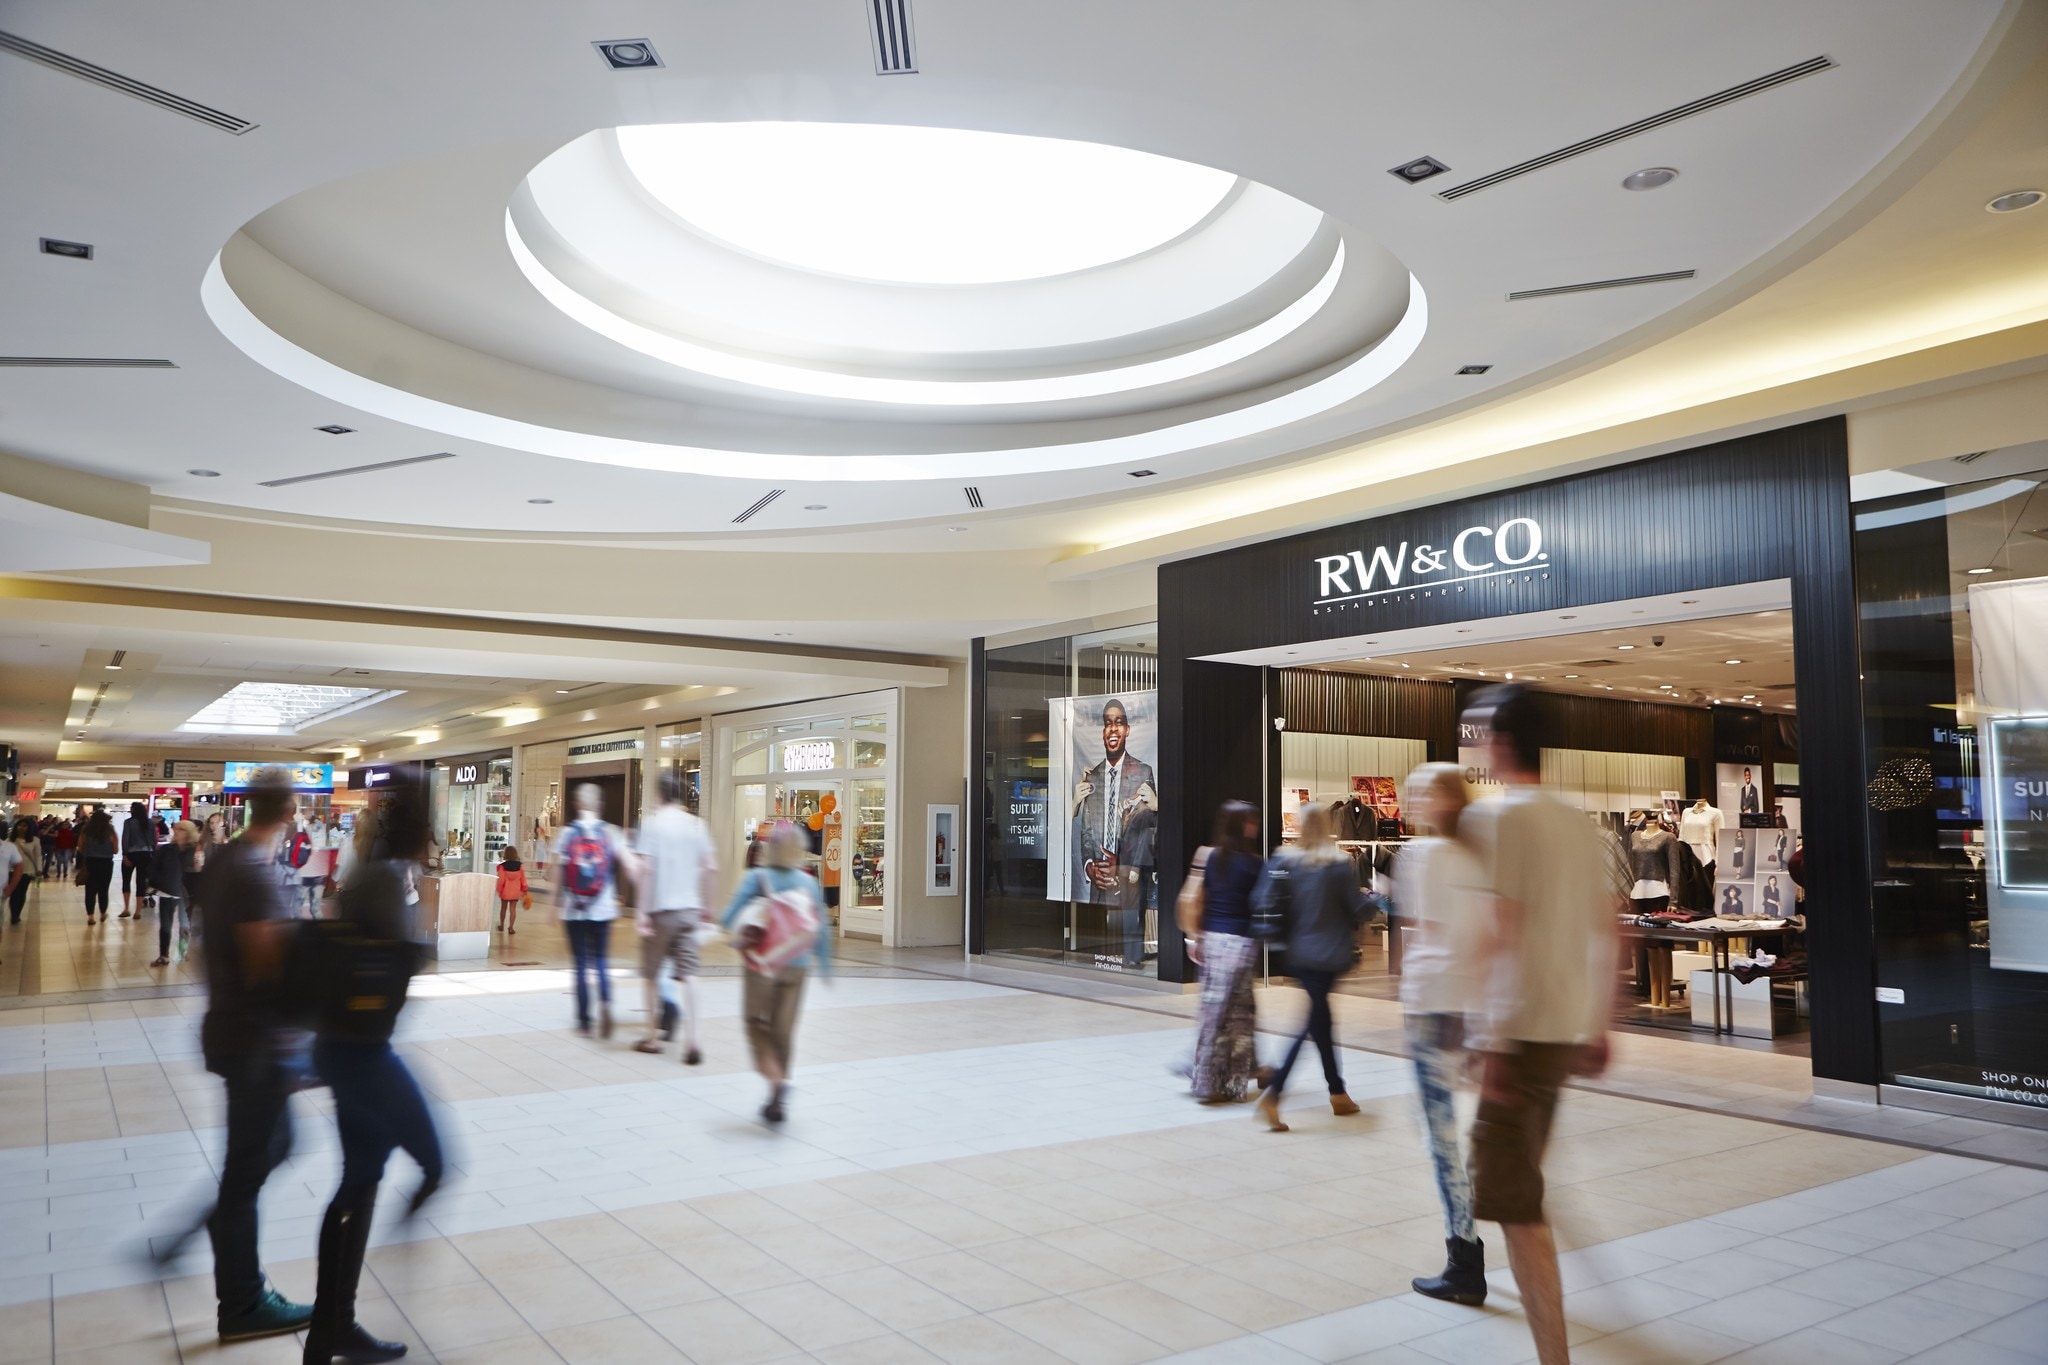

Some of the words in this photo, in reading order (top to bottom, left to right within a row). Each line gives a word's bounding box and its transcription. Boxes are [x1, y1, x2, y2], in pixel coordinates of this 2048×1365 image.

[1314, 517, 1548, 597] RW&CO.
[1313, 585, 1466, 615] ESTABLISHED
[1491, 573, 1549, 588] 1999
[568, 744, 591, 756] AMERICAN
[592, 743, 605, 753] EAGLE
[606, 739, 636, 752] OUTFITTERS
[235, 766, 324, 784] KERELS
[455, 765, 477, 782] ALDO
[1010, 803, 1029, 815] SUIT
[1031, 803, 1043, 814] UP
[1010, 825, 1022, 834] IT'S
[1022, 825, 1043, 834] GAME
[1018, 836, 1035, 845] TIME
[1094, 953, 1106, 961] SHOP
[1107, 955, 1123, 964] ONLINE
[1981, 1070, 2018, 1084] SHOP
[2023, 1076, 2048, 1089] ON
